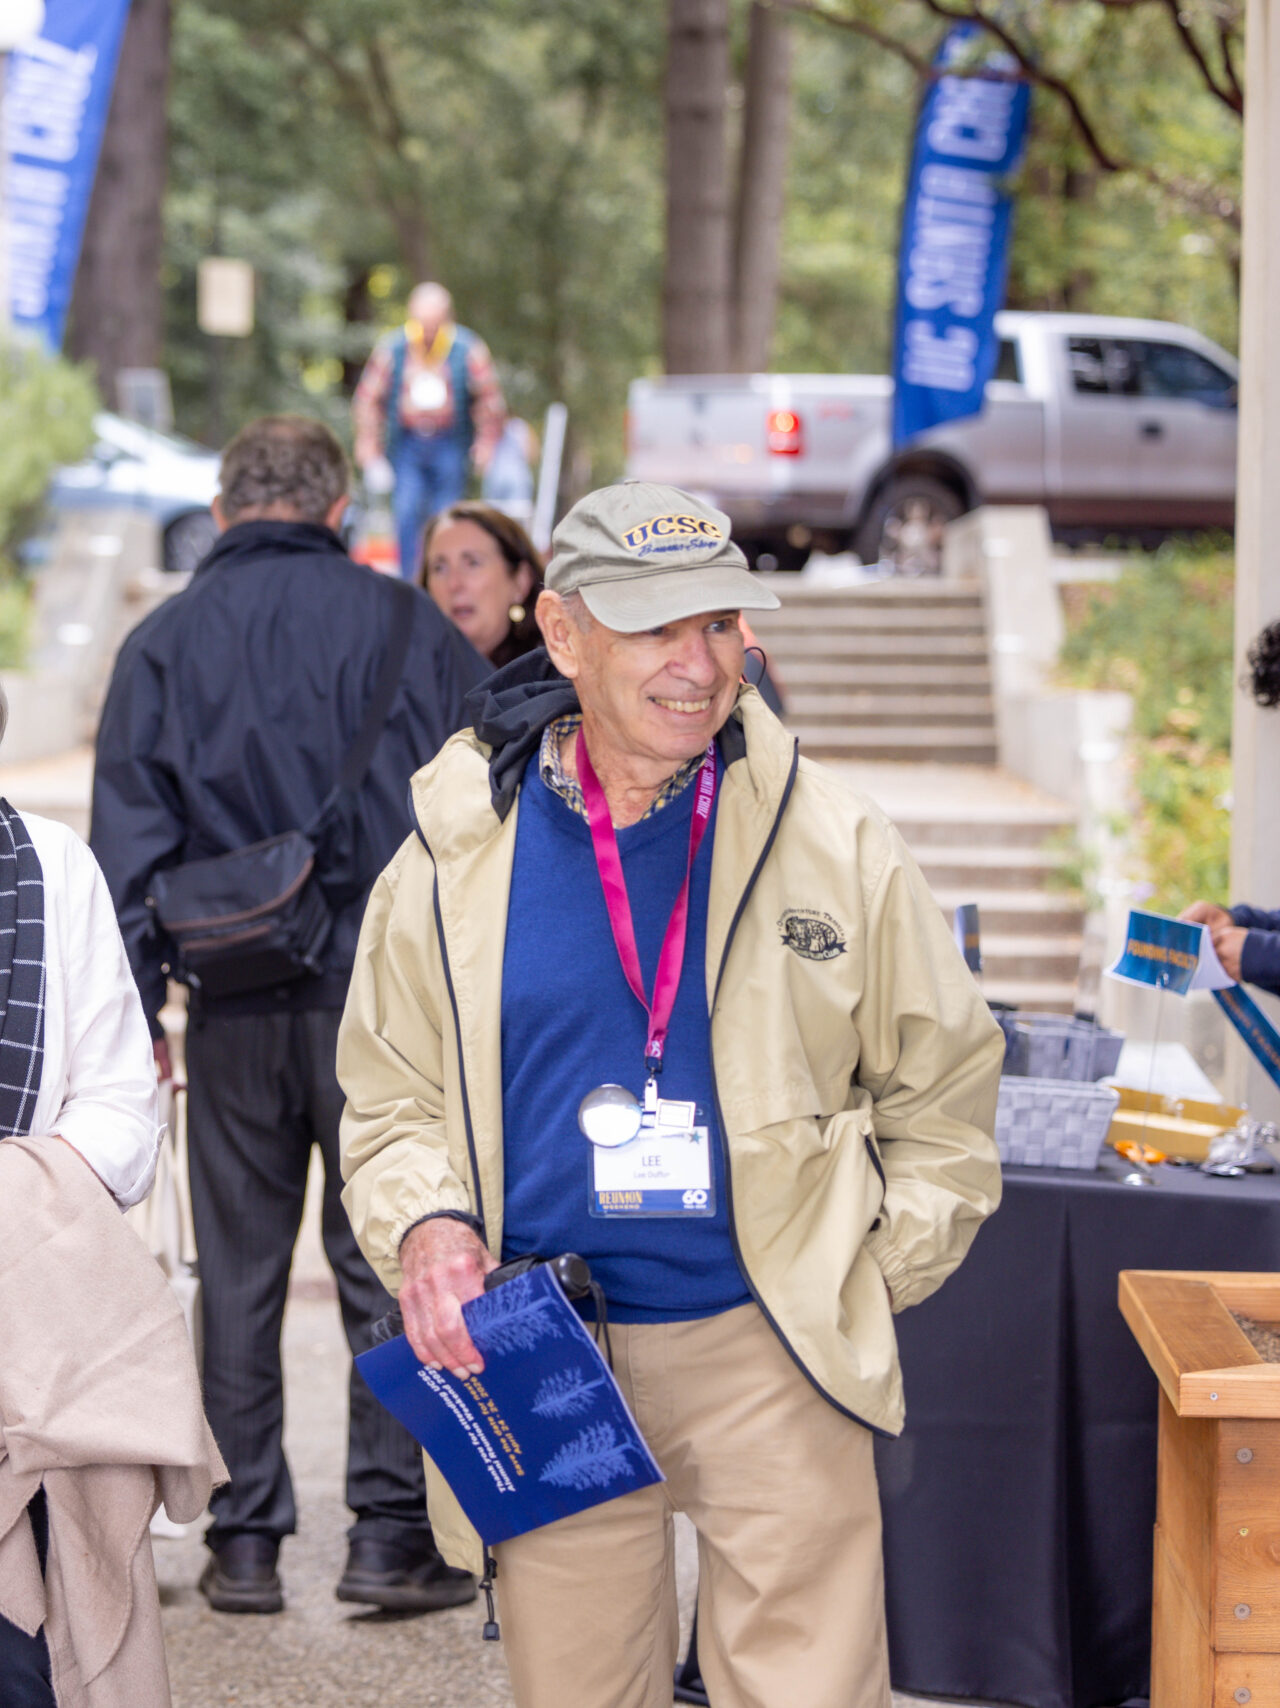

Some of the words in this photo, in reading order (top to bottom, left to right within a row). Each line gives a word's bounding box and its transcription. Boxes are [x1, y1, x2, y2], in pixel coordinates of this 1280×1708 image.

[906, 163, 998, 318] SANTA
[903, 318, 978, 392] UC
[622, 515, 723, 549] UCSC
[642, 1155, 661, 1167] LEE
[599, 1191, 642, 1204] REUNION
[682, 1189, 707, 1205] 60
[417, 1370, 440, 1392] UCSC
[439, 1391, 471, 1430] attending
[442, 1384, 474, 1422] Weekend
[477, 1402, 489, 1415] for
[487, 1416, 502, 1436] date
[468, 1431, 480, 1446] for
[472, 1422, 497, 1459] Reunion
[500, 1437, 511, 1453] the
[504, 1432, 522, 1454] April
[477, 1446, 491, 1463] you
[509, 1454, 525, 1476] Save
[488, 1465, 506, 1493] Thank
[493, 1460, 516, 1492] Alumni
